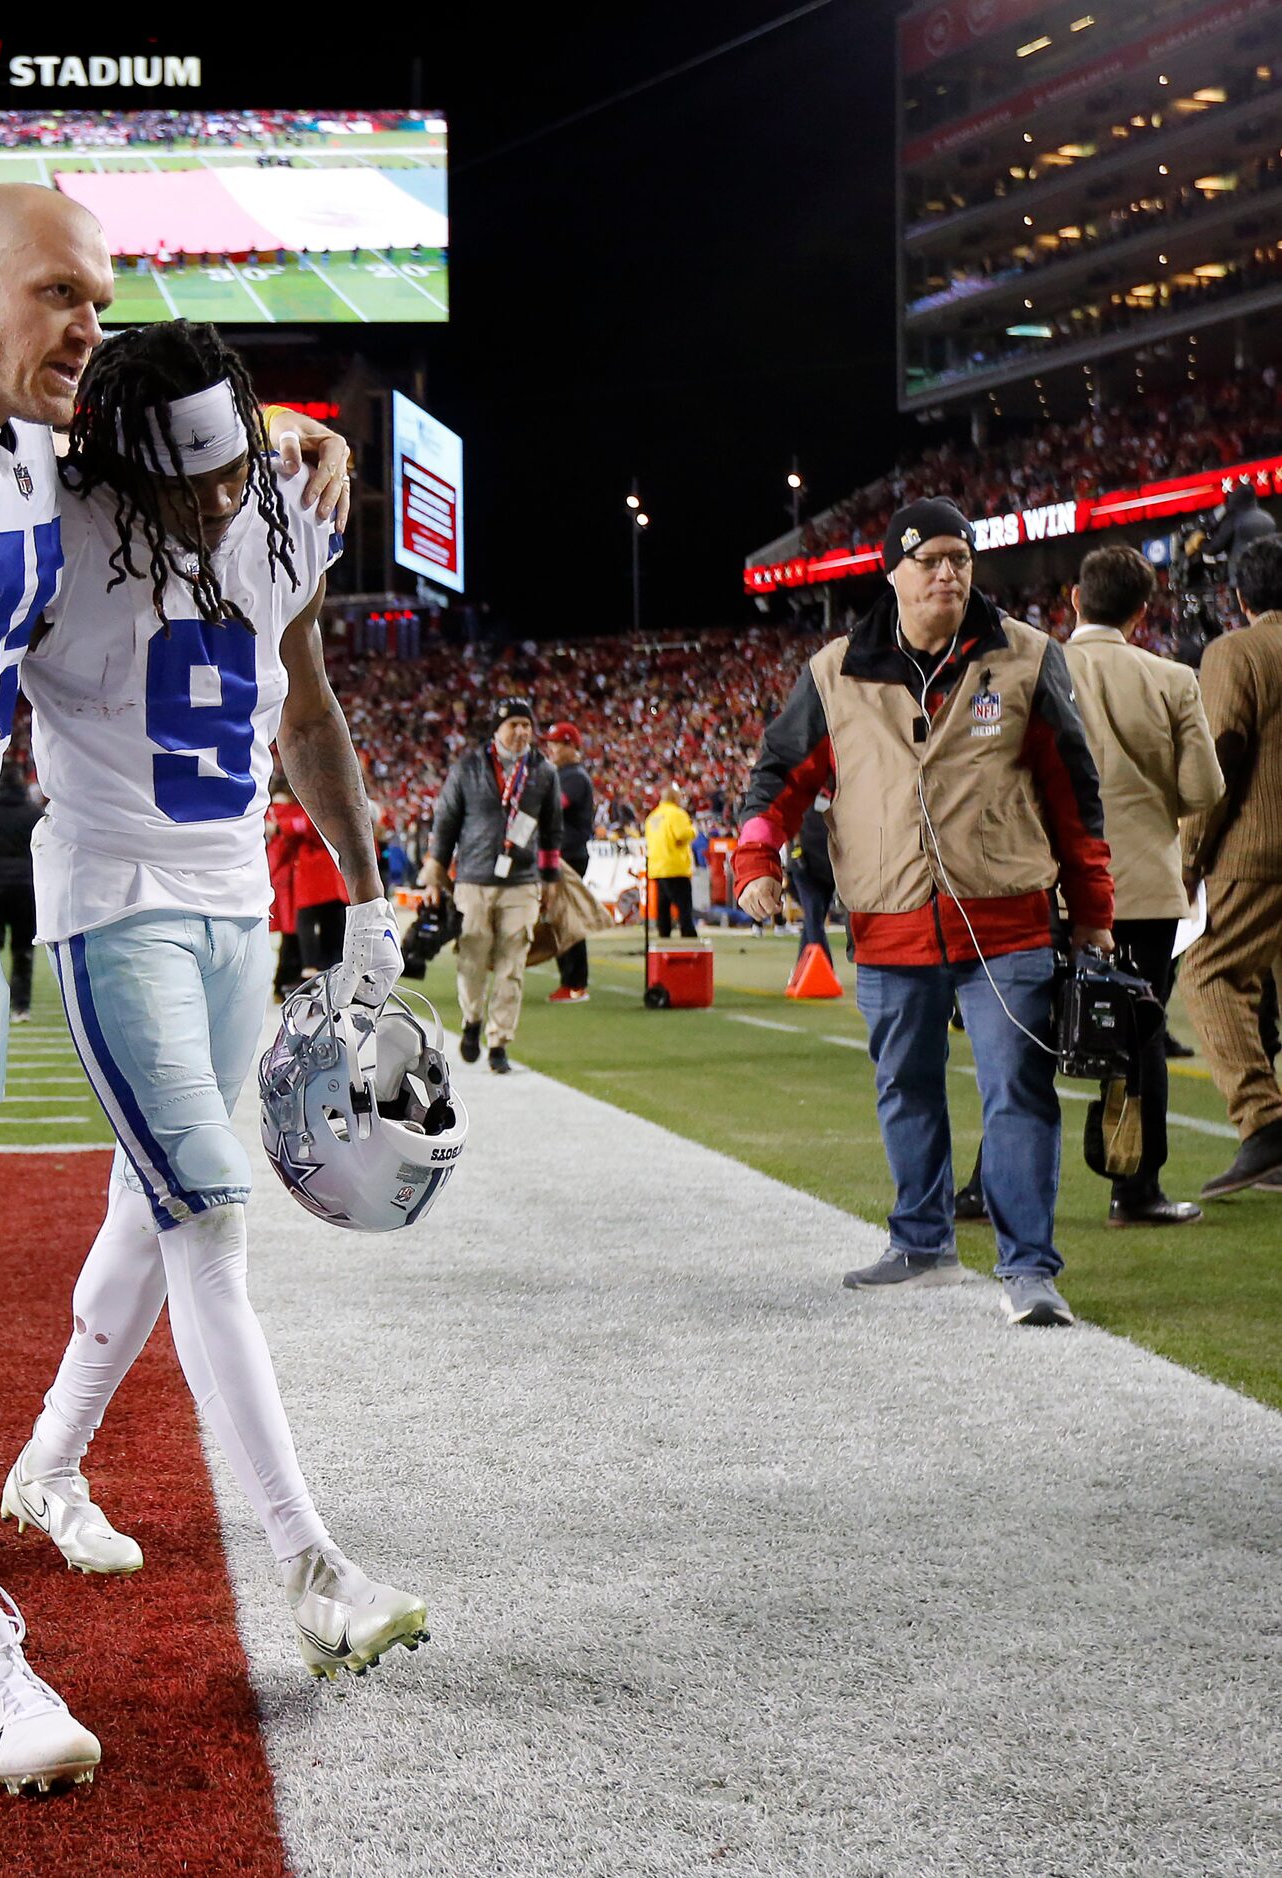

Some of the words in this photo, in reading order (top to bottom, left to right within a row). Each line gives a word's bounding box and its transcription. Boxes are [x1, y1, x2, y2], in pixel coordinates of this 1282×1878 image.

[9, 56, 201, 87] STADIUM
[971, 513, 1019, 552] ERS
[1022, 500, 1077, 541] WIN
[146, 619, 258, 823] 9
